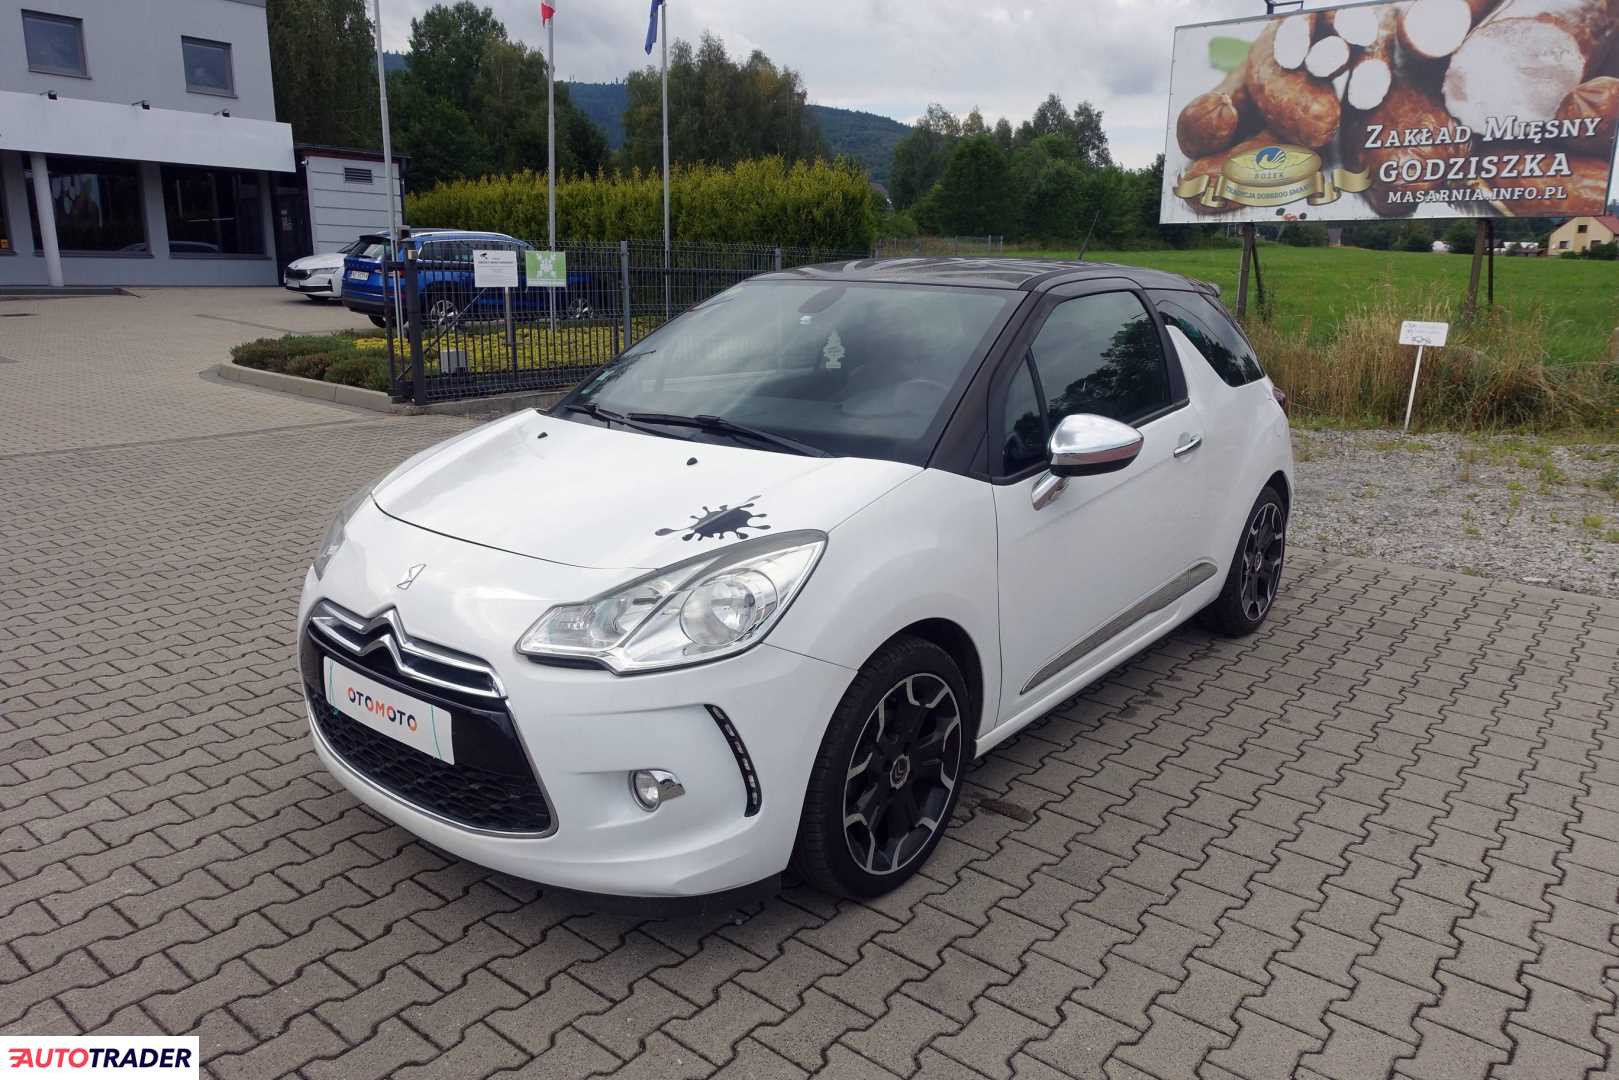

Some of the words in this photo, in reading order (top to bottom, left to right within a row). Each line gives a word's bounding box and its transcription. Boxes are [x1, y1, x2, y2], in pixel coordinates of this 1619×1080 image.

[1364, 124, 1472, 149] ZAKŁAD
[1483, 115, 1602, 144] MIĘSNY
[1379, 153, 1573, 183] GODZISZKA
[347, 687, 418, 732] OTOMOTO
